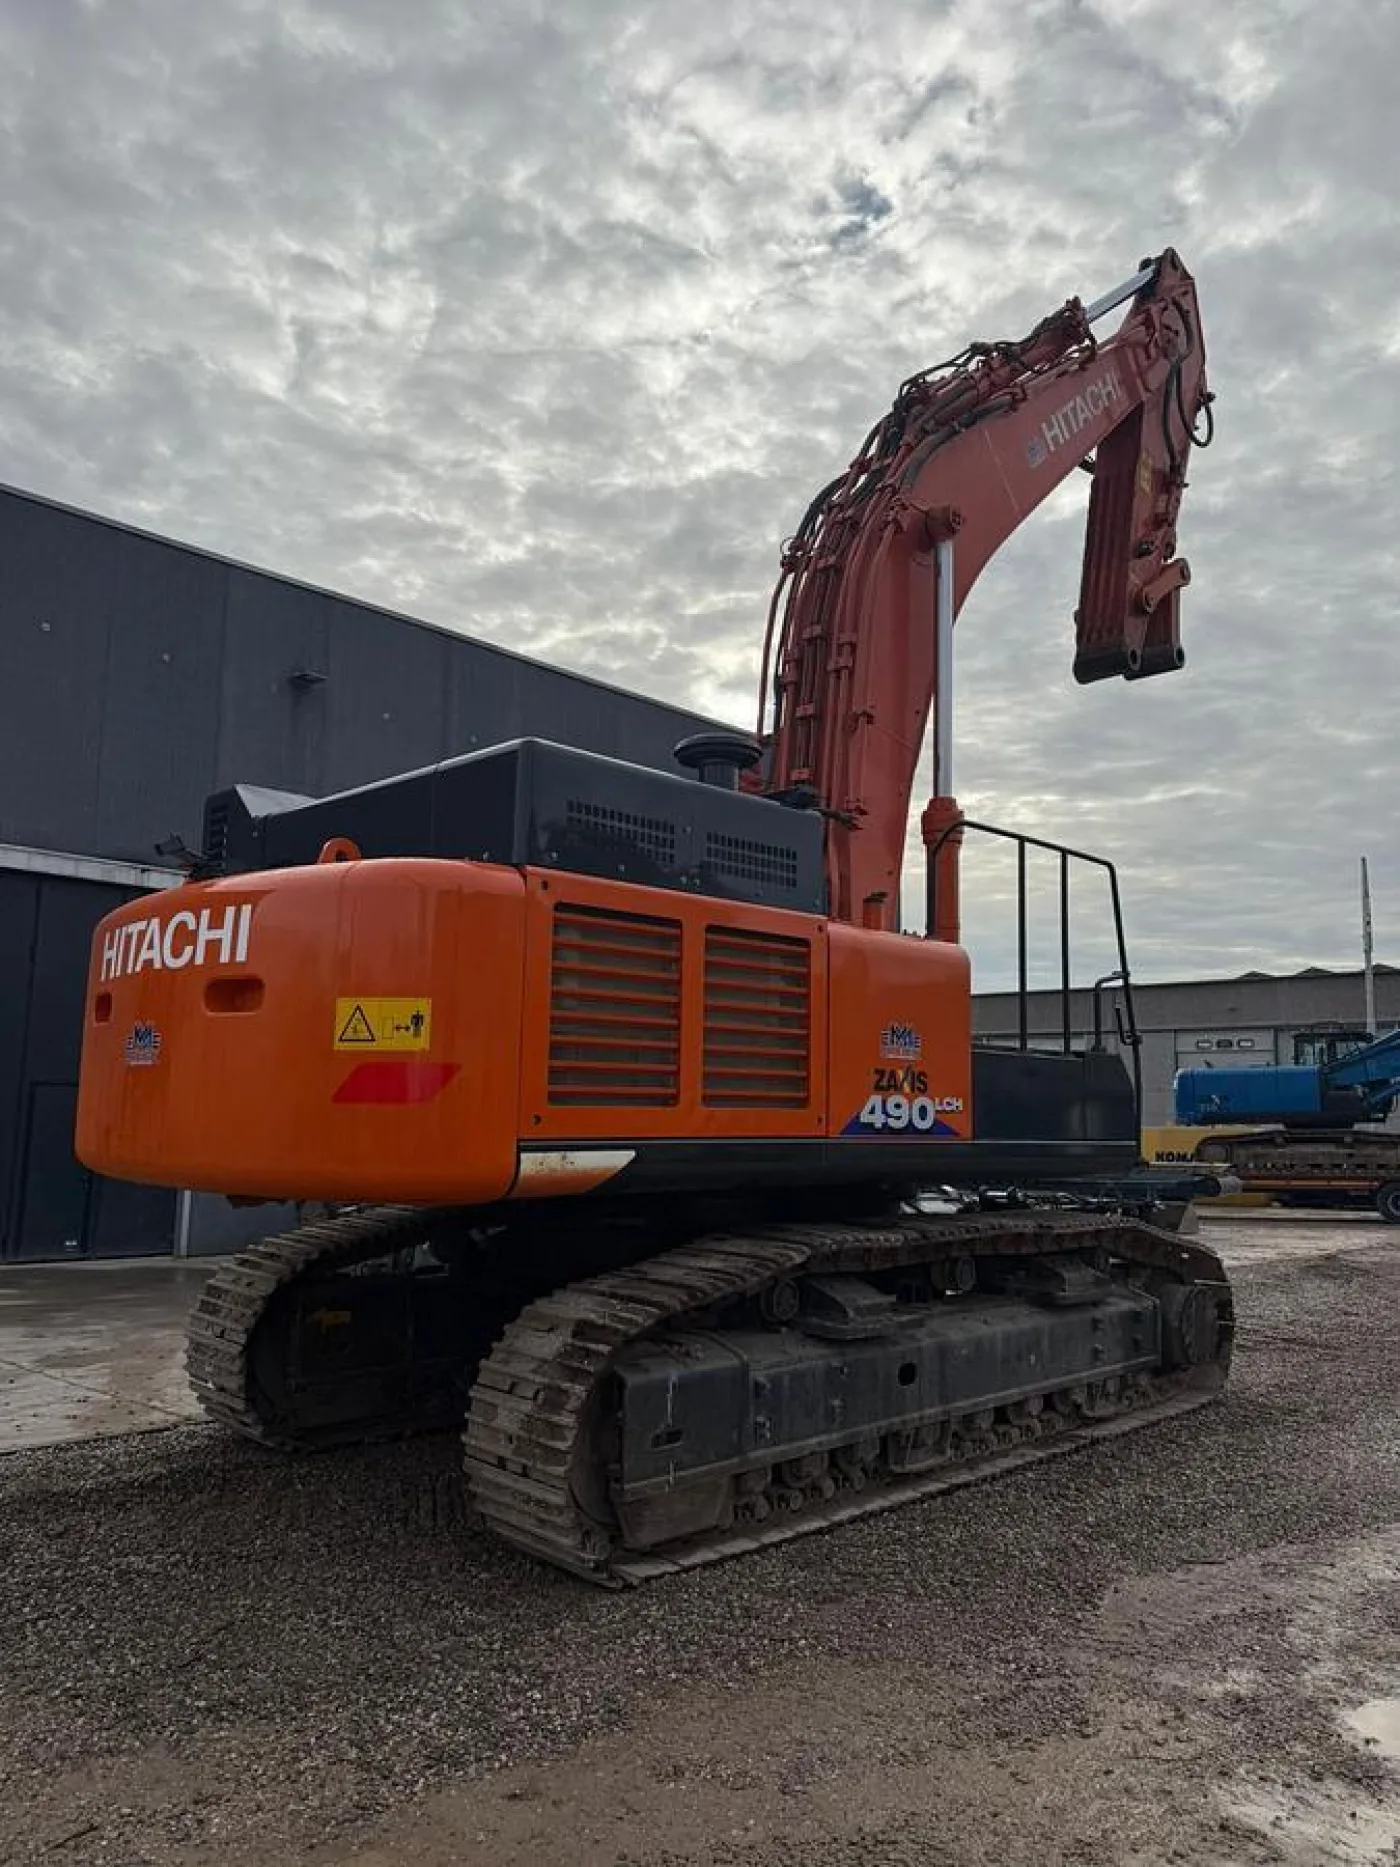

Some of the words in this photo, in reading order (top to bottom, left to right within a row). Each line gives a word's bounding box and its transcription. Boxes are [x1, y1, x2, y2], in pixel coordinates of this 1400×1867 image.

[1041, 371, 1122, 451] HITACHI
[99, 903, 252, 982] HITACHI
[873, 1065, 928, 1094] ZAXIS
